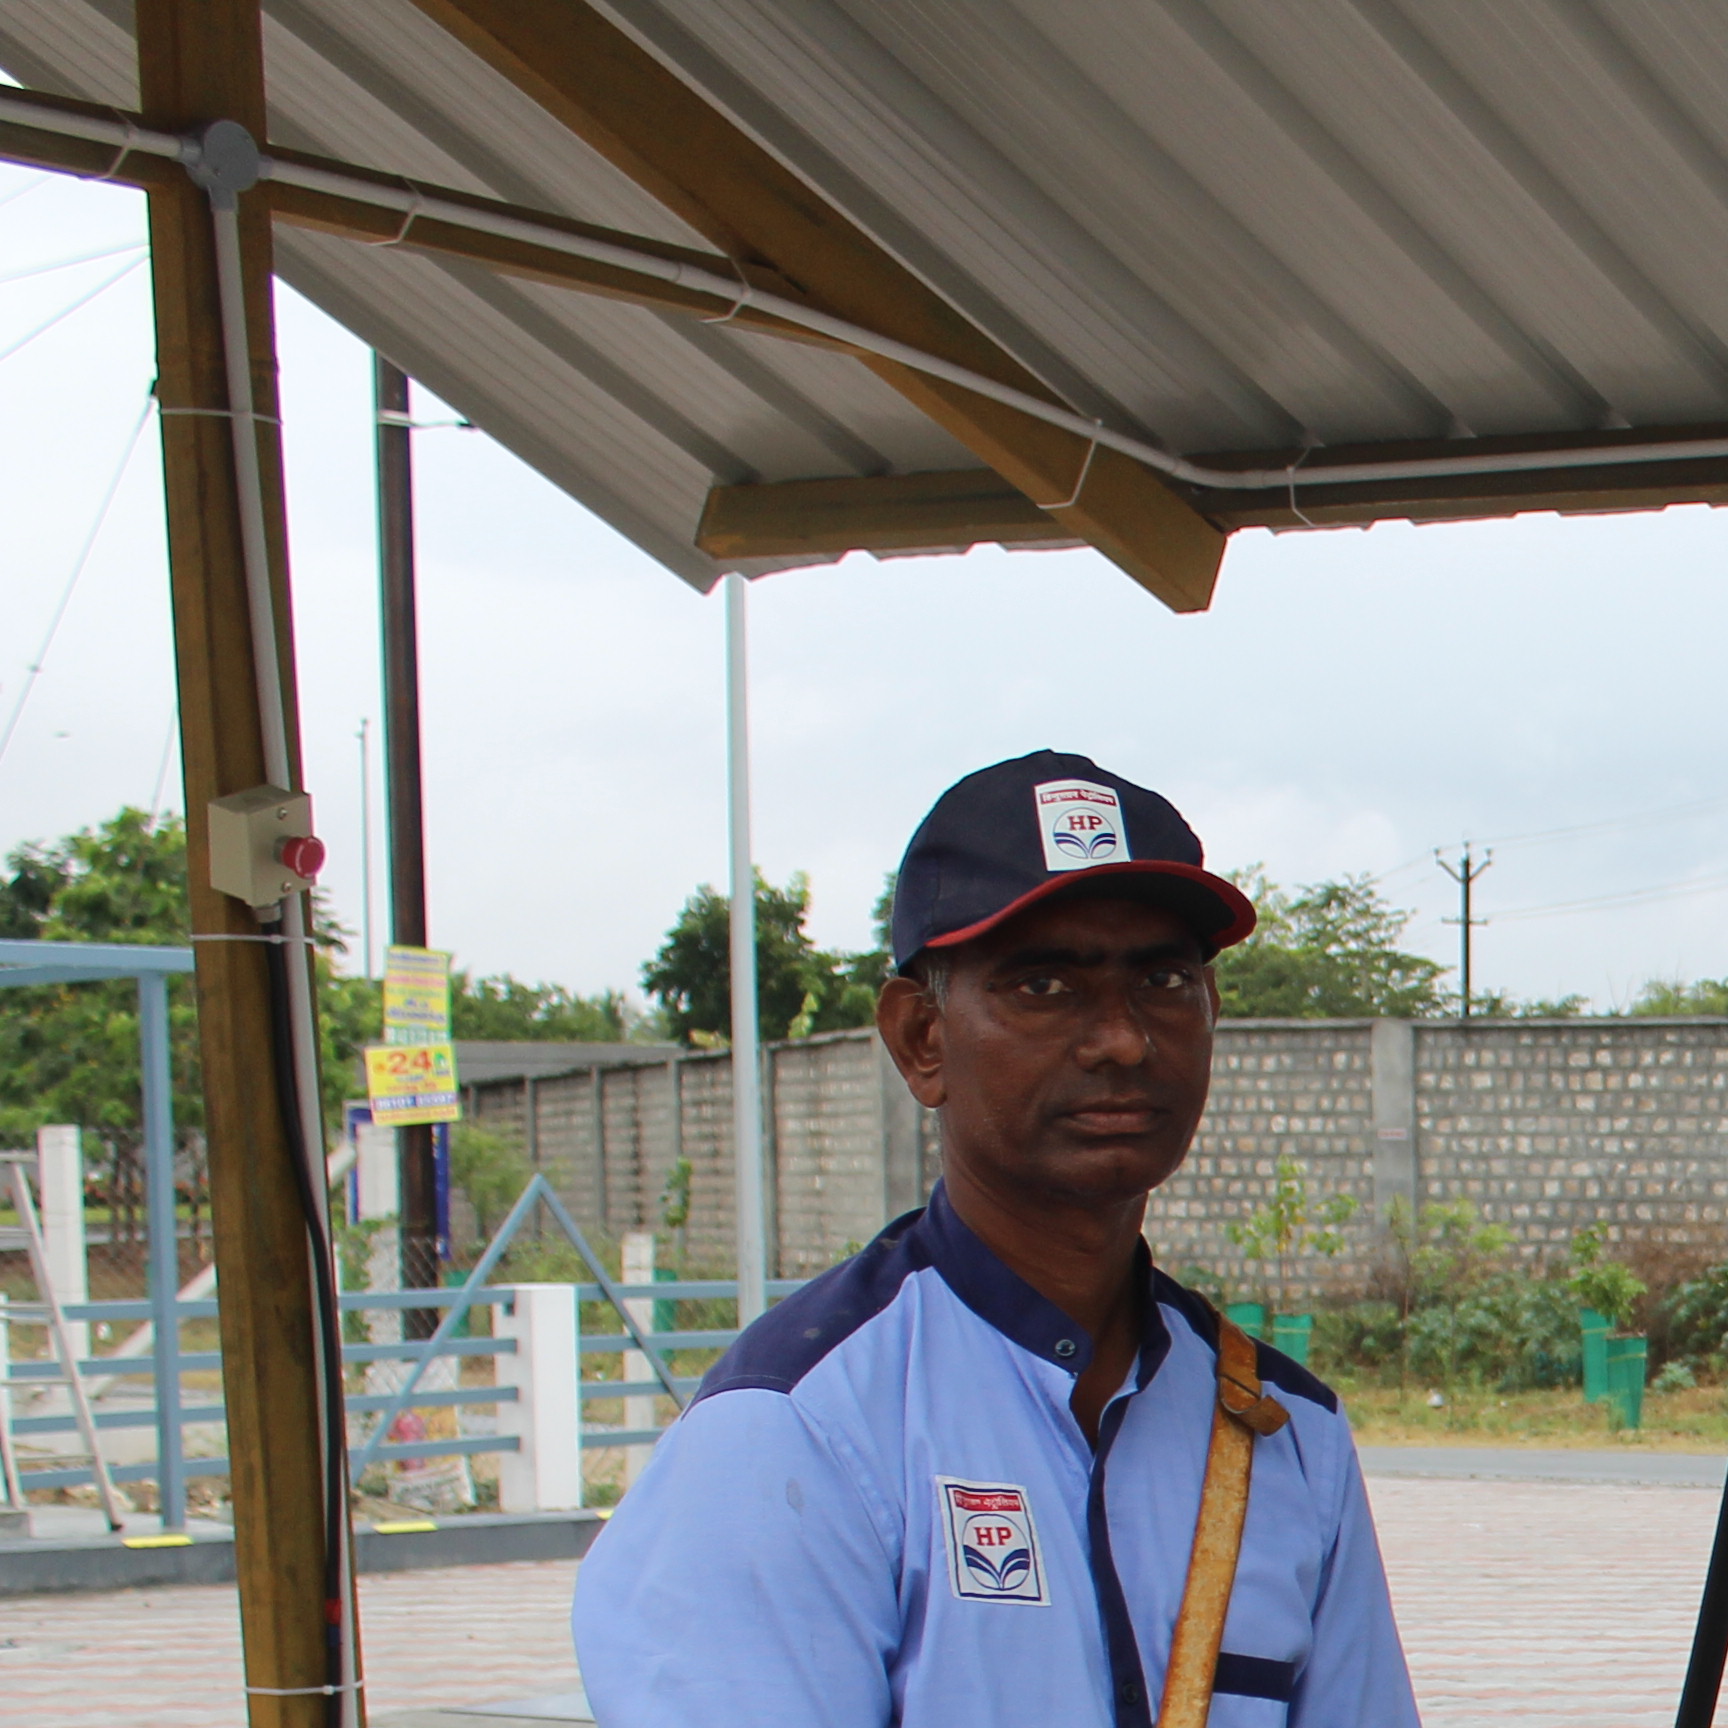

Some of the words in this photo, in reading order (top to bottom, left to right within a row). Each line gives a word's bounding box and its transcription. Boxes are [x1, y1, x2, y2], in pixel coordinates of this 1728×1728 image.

[1067, 815, 1103, 830] HP
[388, 1051, 433, 1075] 24
[973, 1527, 1013, 1546] HP
